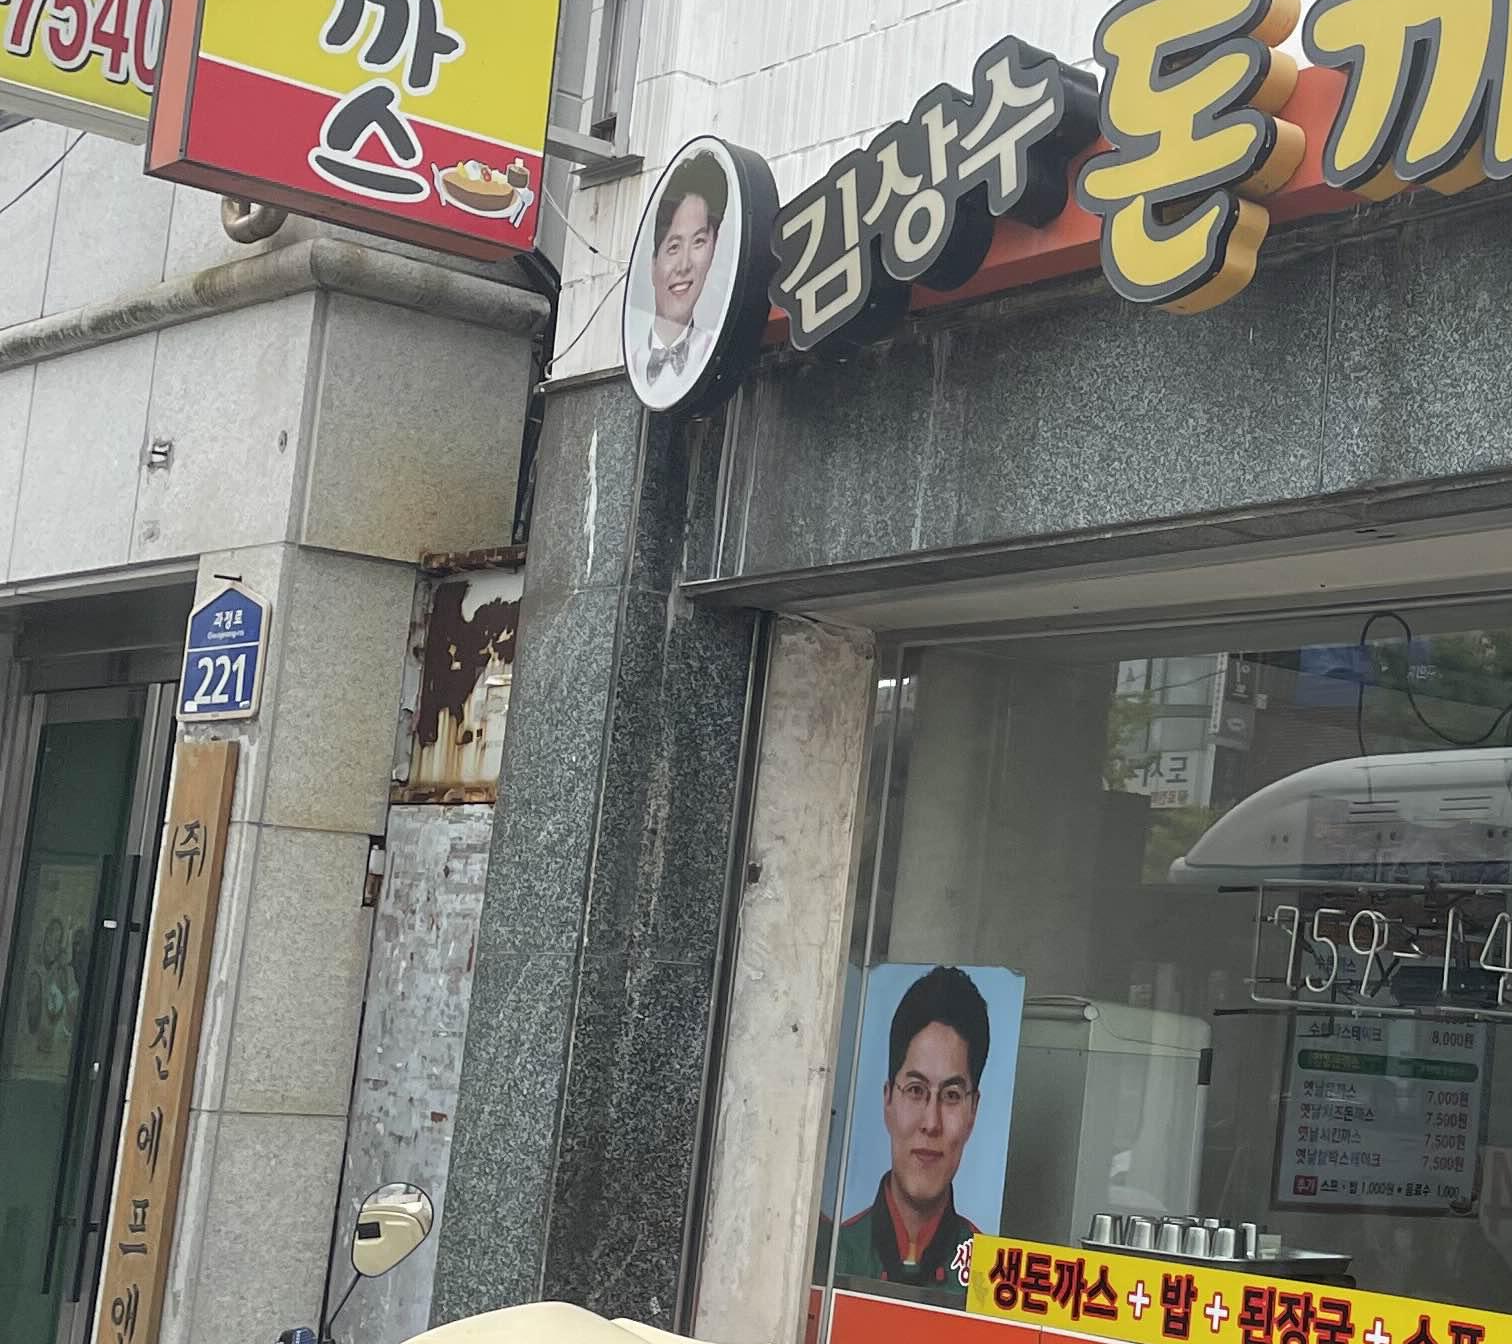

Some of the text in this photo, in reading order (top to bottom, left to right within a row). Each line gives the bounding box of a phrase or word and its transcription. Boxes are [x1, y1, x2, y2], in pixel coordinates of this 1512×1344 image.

[778, 51, 1058, 338] 김상수
[213, 609, 244, 630] 과정로
[194, 653, 247, 705] 221
[989, 1247, 1119, 1321] 생돈까스
[1160, 1273, 1197, 1340] 밥
